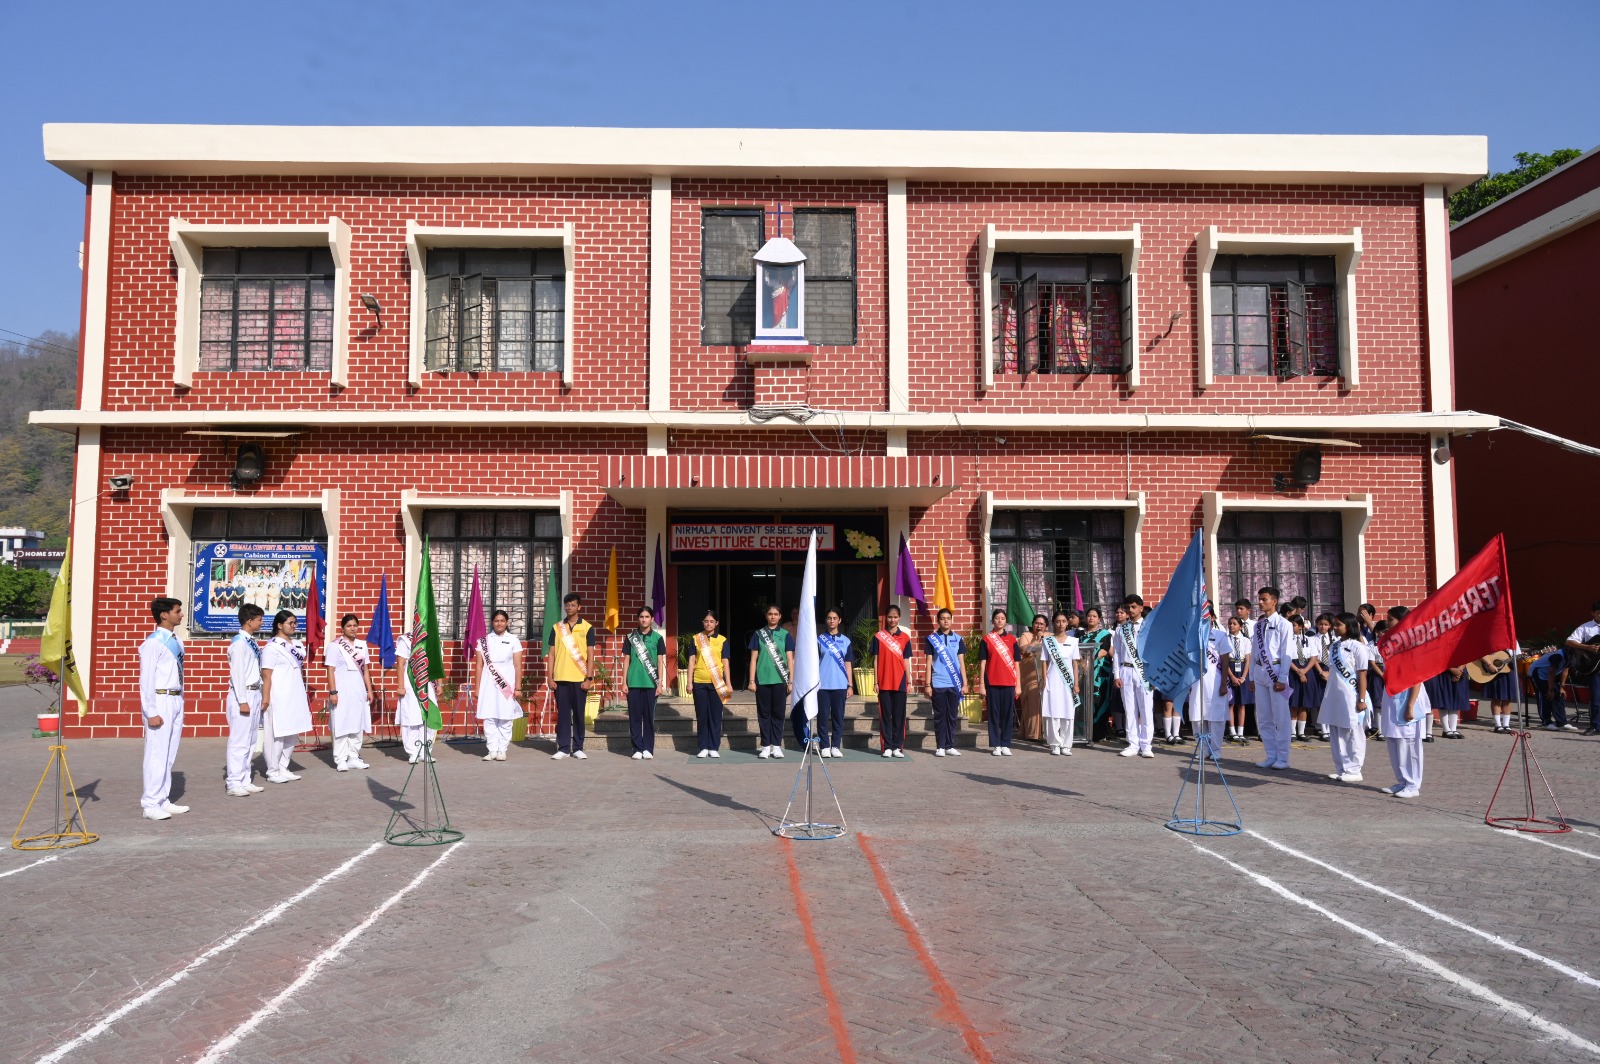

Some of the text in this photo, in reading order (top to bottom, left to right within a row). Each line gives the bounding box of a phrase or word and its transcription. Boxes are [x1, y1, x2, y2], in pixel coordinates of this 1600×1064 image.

[675, 526, 717, 534] NIRMALA
[720, 526, 762, 534] CONVENT
[675, 536, 824, 549] INVESTITURE CEREMOY
[338, 638, 363, 666] VICE L A
[1046, 636, 1056, 648] VICE
[941, 650, 956, 674] PATAUDI
[1050, 648, 1073, 684] CLEANLINESS
[1260, 649, 1279, 683] CAPTAIN
[1332, 656, 1351, 679] HEAD
[488, 664, 508, 690] CAPTAIN
